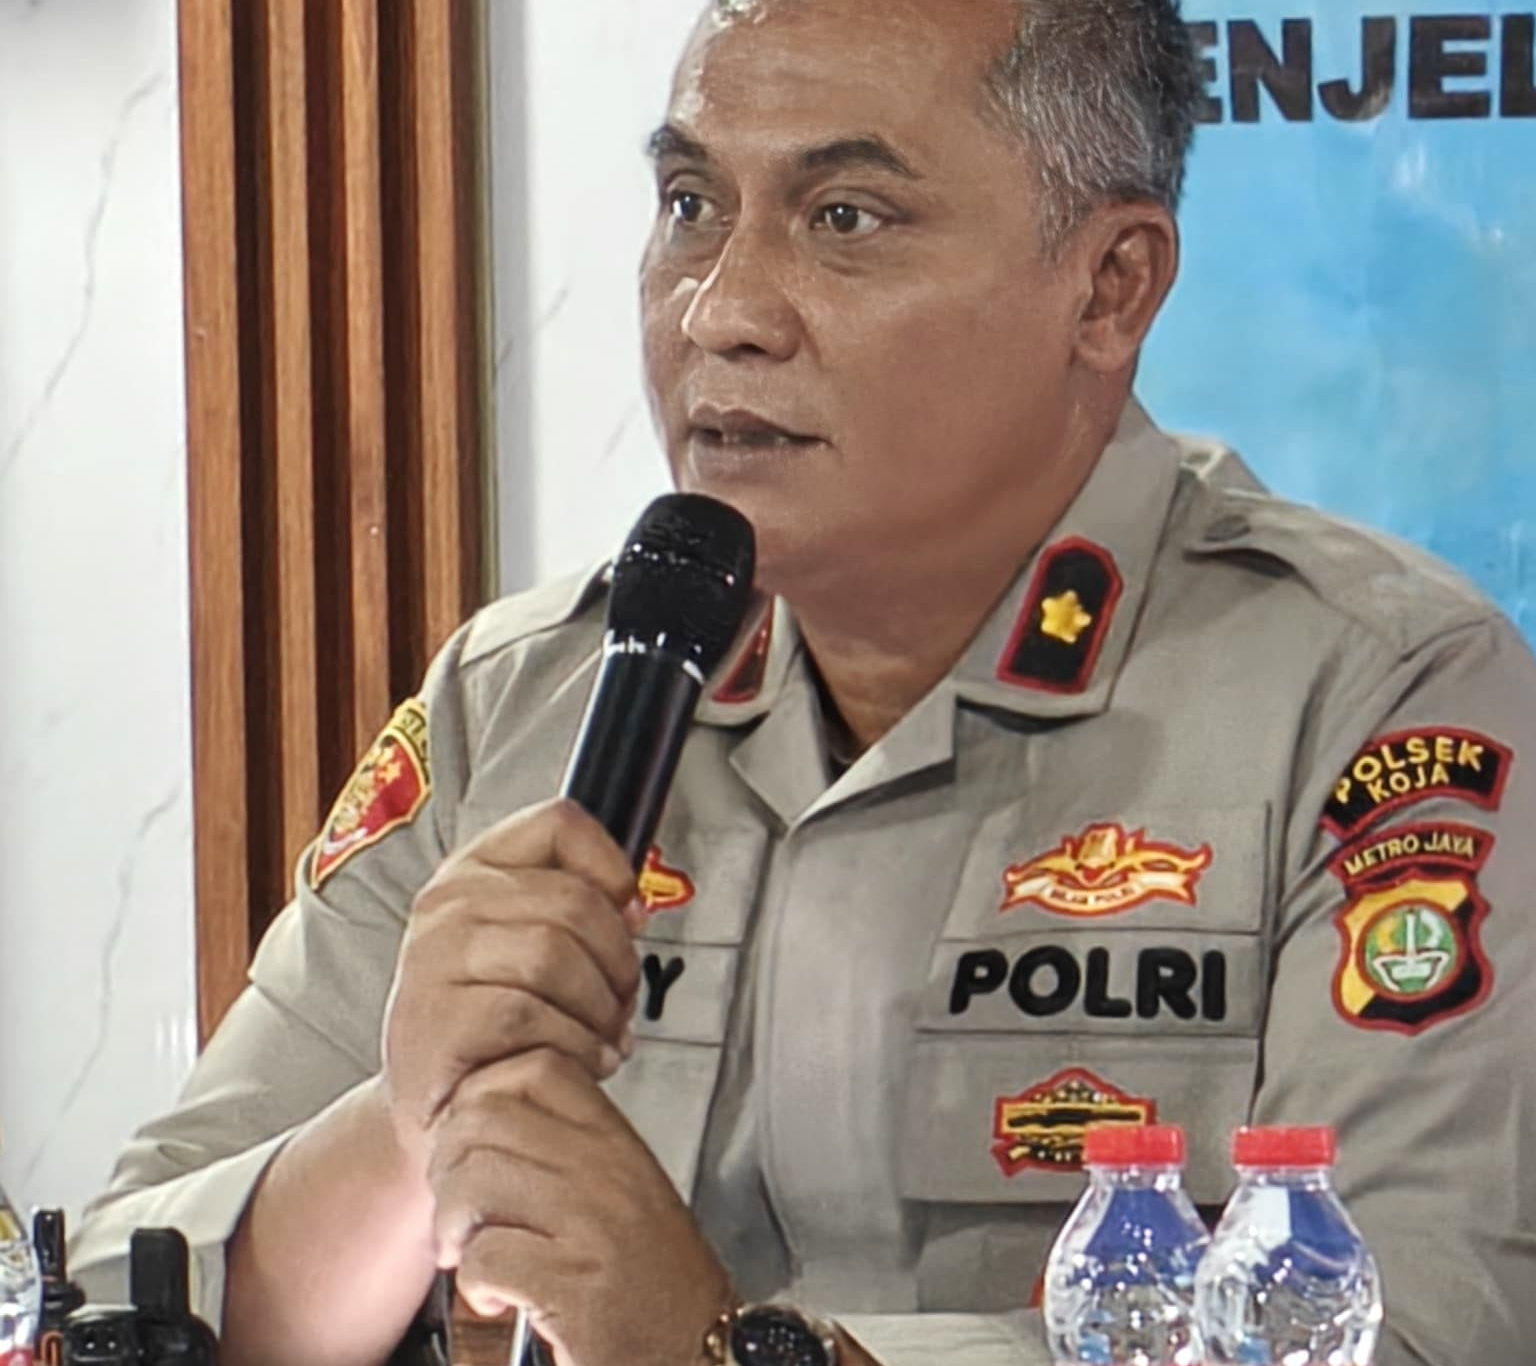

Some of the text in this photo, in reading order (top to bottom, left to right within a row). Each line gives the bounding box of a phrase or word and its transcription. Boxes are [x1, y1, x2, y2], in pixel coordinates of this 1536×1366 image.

[1335, 736, 1483, 804] POLSEK
[1366, 763, 1449, 804] KOJA
[1344, 831, 1474, 876] METRO JAYA
[948, 945, 1227, 1022] POLRI
